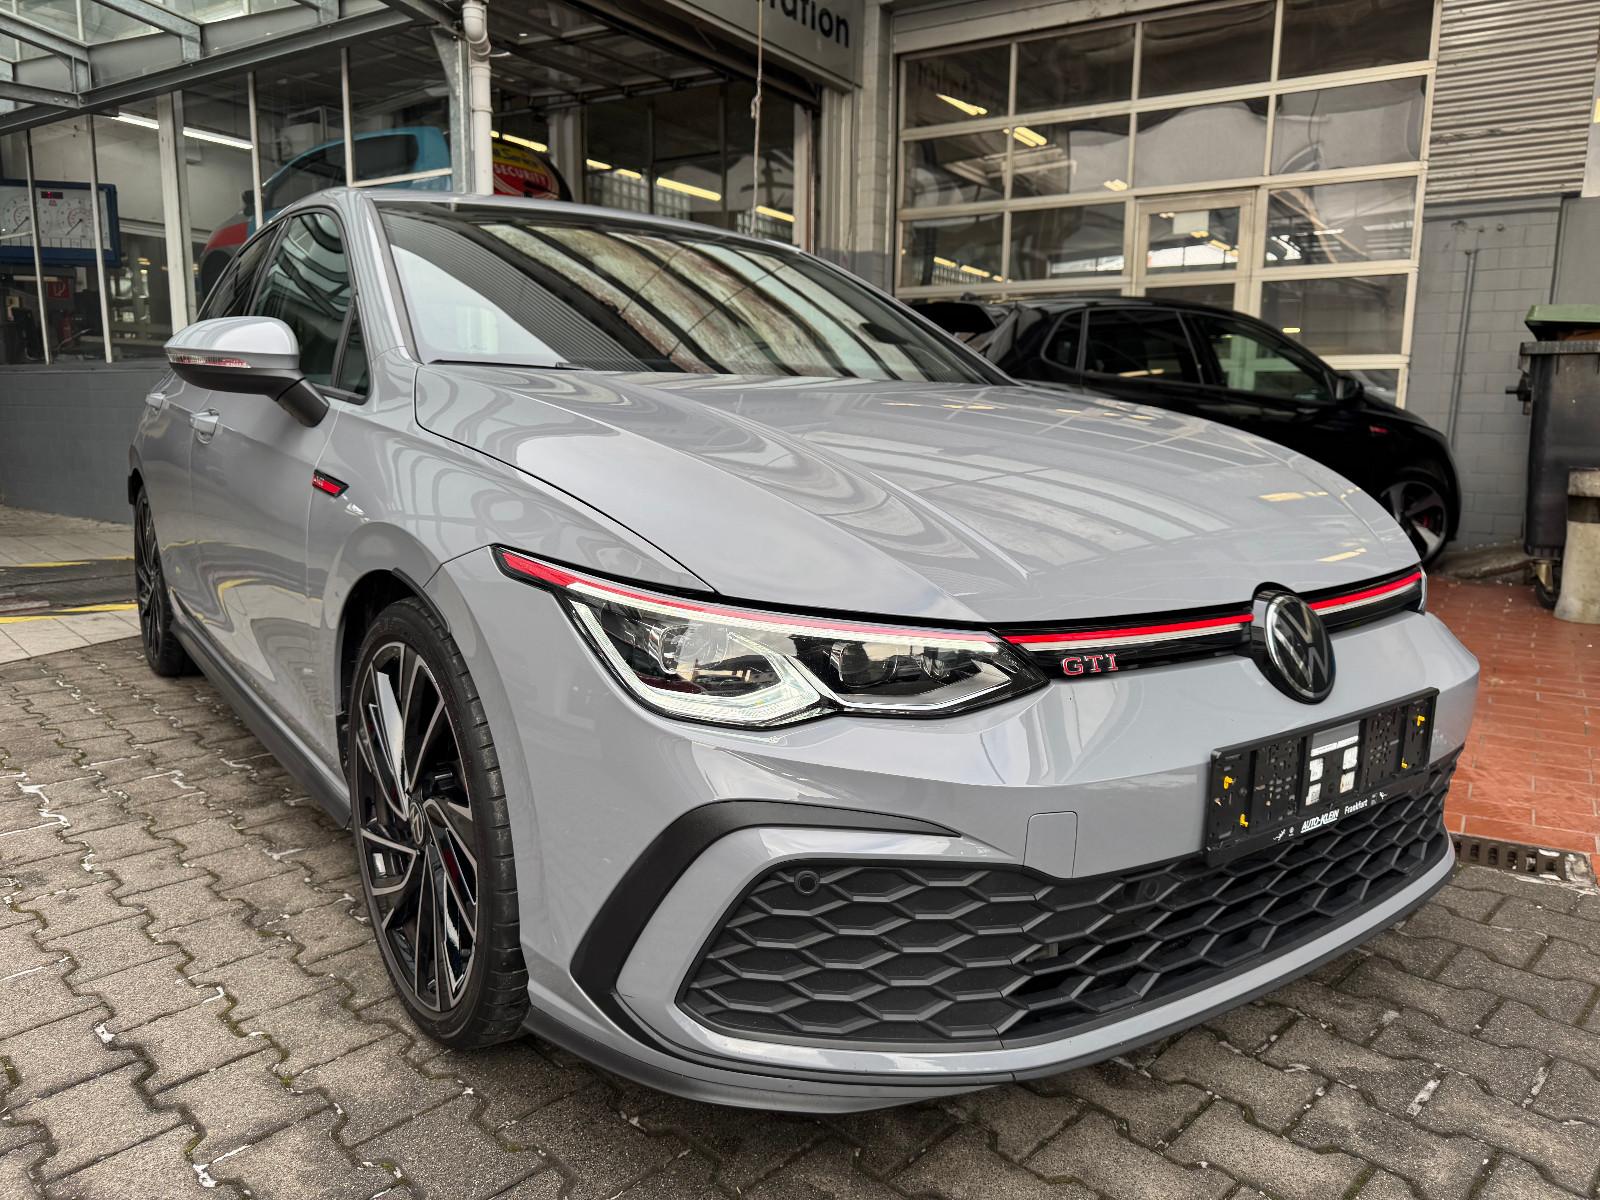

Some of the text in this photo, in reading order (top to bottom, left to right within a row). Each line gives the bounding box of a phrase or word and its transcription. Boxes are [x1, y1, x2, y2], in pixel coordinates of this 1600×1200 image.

[769, 0, 849, 48] ation
[1062, 653, 1119, 676] GTI
[1301, 808, 1340, 832] AUTO-KLEIN
